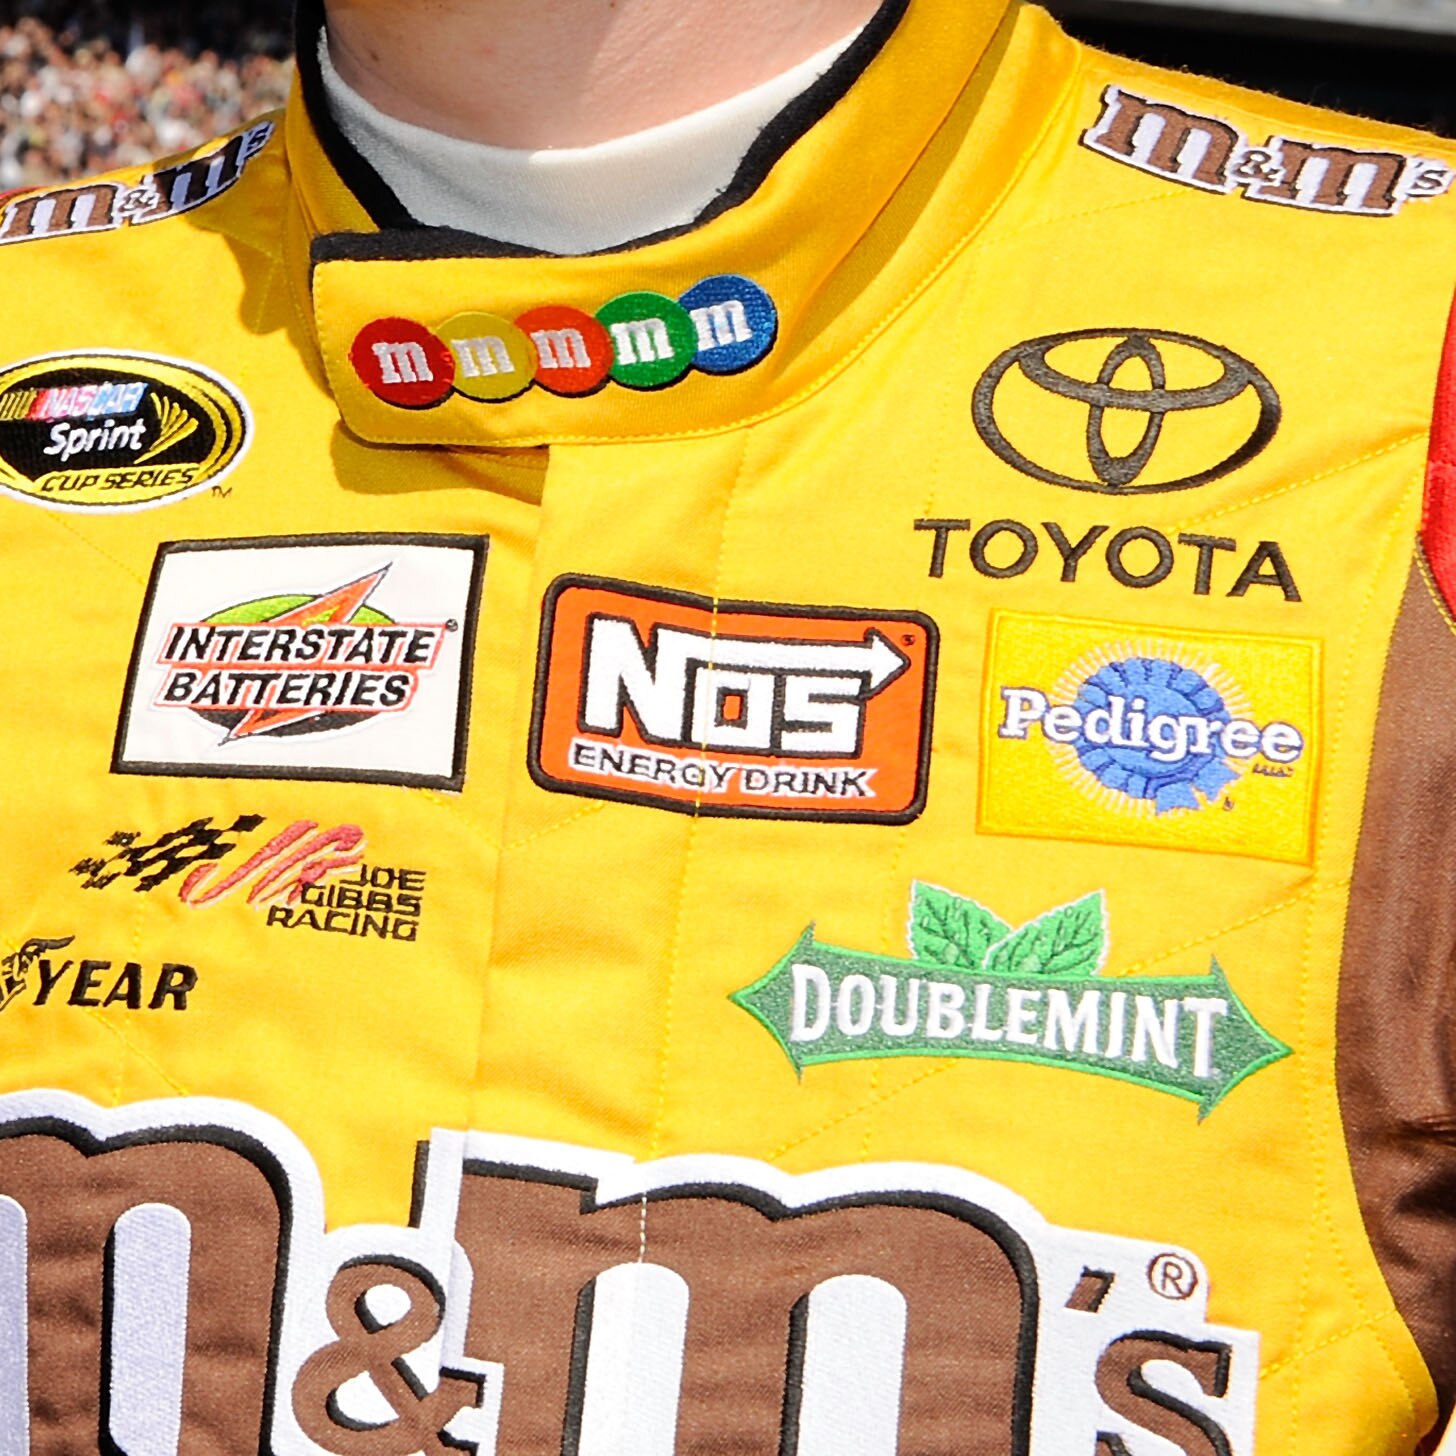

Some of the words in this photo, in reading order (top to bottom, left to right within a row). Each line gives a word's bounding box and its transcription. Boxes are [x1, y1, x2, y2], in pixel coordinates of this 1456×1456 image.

[41, 383, 149, 418] NASCAR
[43, 418, 147, 462] Sprint
[40, 471, 97, 492] CUP
[99, 467, 200, 490] SERIES
[913, 518, 1302, 603] TOYOTA
[164, 626, 435, 664] INTERSTATE
[163, 671, 410, 708] BATTERIES
[577, 611, 911, 760] NOS
[997, 686, 1304, 764] Pedigree
[573, 742, 736, 789] ENERGY
[744, 766, 875, 798] DRINK
[339, 863, 426, 892] JOE
[300, 882, 422, 918] GIBBS
[267, 905, 419, 942] RACING
[788, 963, 1228, 1079] DOUBLEMINT
